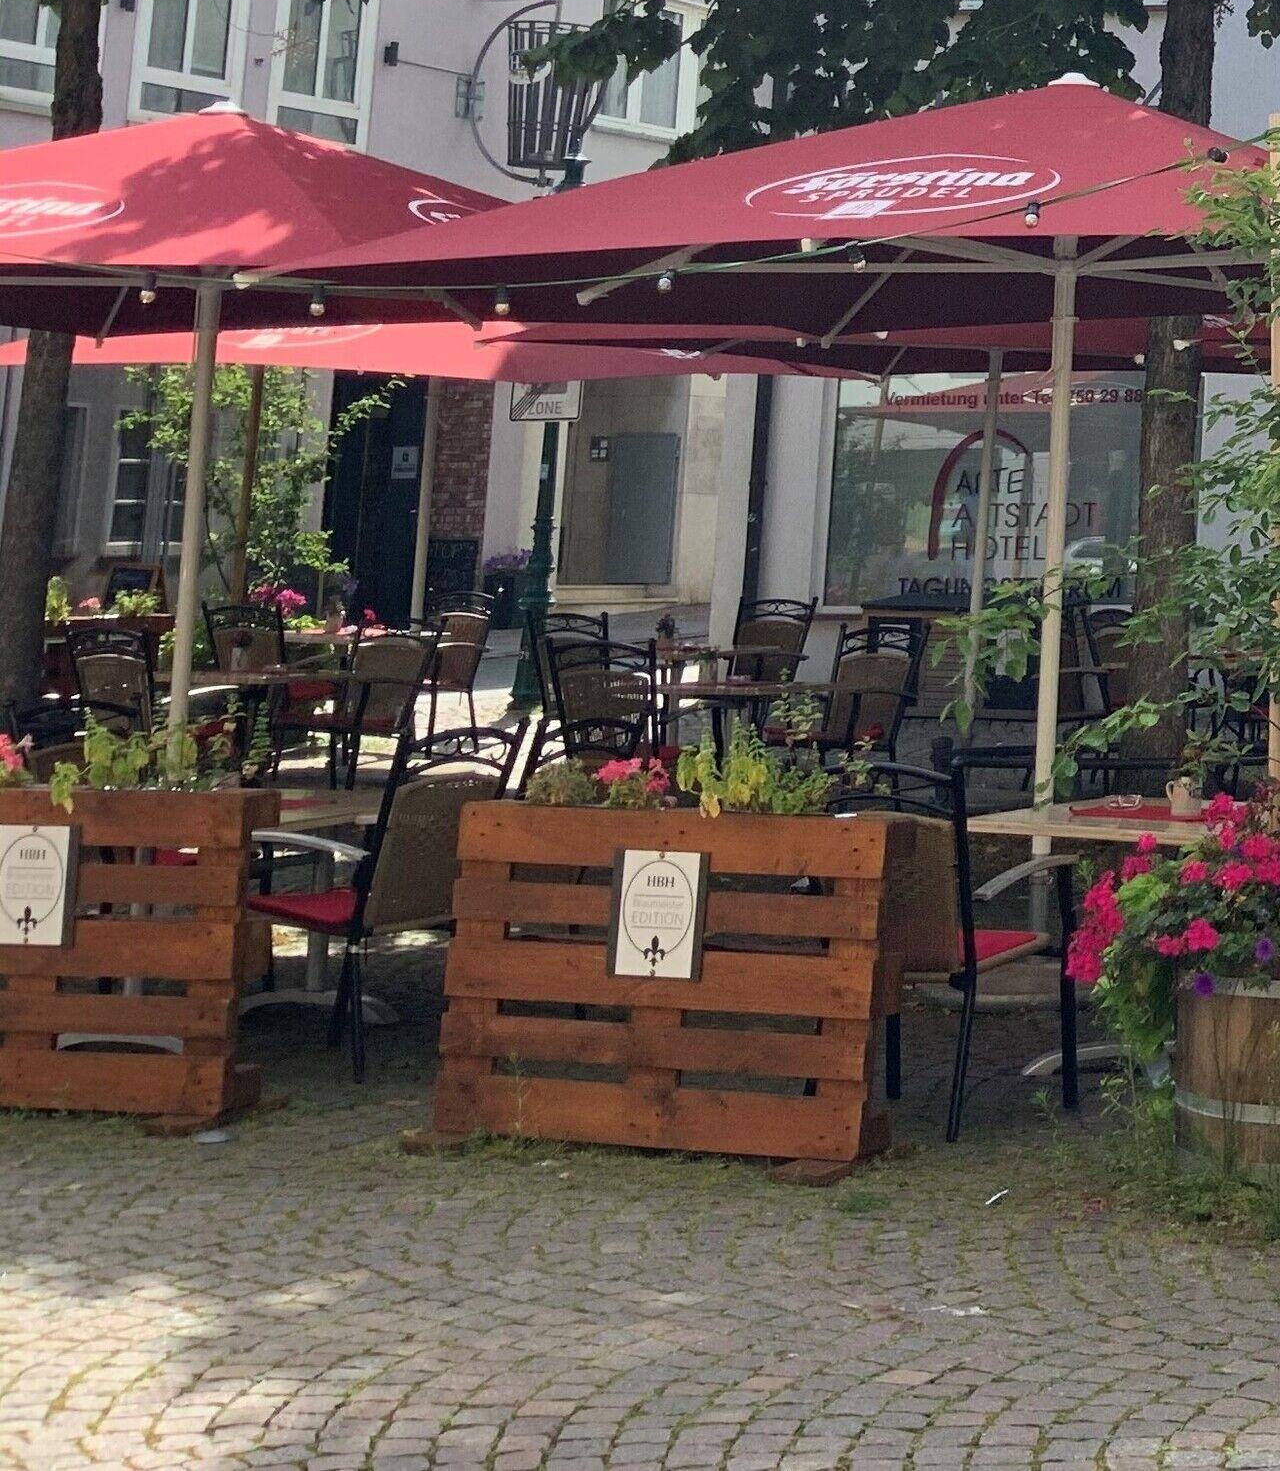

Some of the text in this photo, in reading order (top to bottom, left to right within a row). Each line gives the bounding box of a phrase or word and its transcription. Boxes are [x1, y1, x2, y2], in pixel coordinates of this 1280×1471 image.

[799, 186, 972, 203] SPRUDEL
[885, 390, 978, 408] Vermietung
[1100, 389, 1119, 403] 29
[527, 400, 564, 415] ZONE
[952, 502, 1096, 528] ATSTADT
[646, 875, 675, 888] HBH
[631, 910, 685, 926] EDITION
